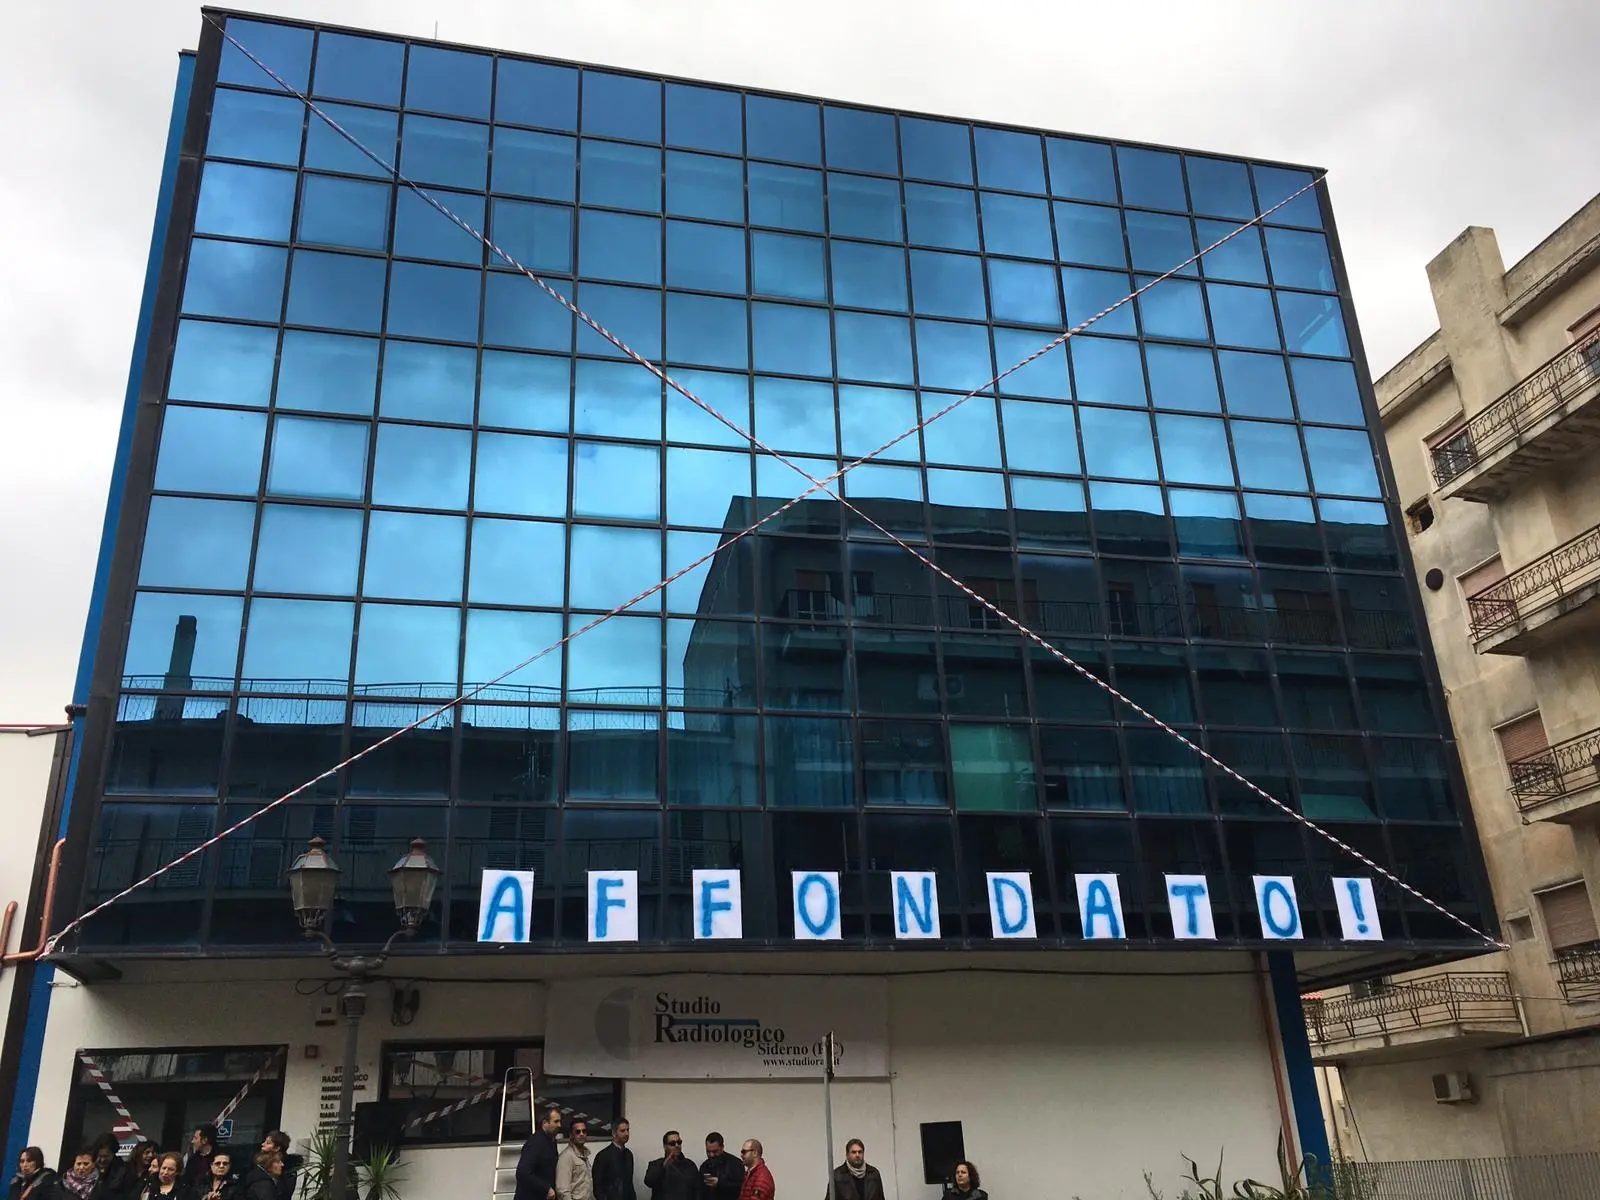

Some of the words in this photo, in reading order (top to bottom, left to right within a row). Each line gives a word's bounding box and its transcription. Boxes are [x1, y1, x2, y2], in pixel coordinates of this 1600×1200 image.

[655, 991, 721, 1015] Studio
[653, 1013, 785, 1047] Radiologico
[757, 1042, 809, 1056] Siderno
